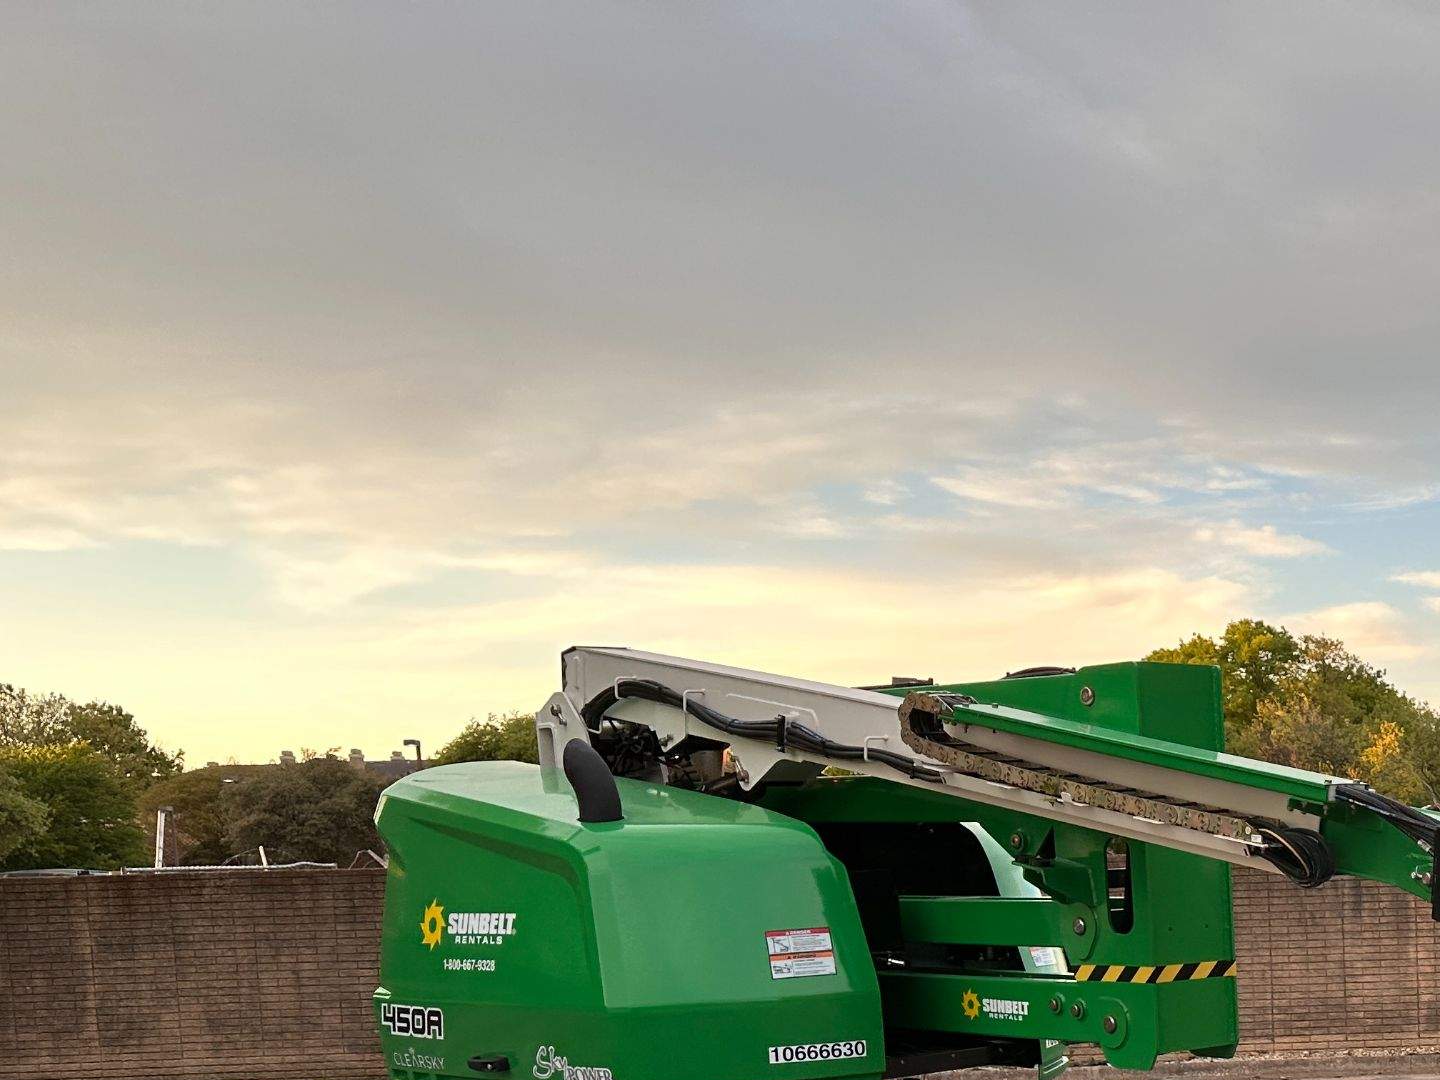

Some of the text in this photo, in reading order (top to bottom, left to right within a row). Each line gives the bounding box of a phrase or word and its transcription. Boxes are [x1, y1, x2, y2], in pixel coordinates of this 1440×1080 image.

[447, 912, 517, 935] SUNBELT
[454, 935, 503, 945] RENTALS
[443, 958, 496, 972] 1-800-667-9328
[982, 998, 1029, 1016] SUNBELT
[988, 1012, 1023, 1021] RENTALS
[381, 1003, 444, 1040] 450A
[393, 1049, 445, 1070] CLEARSKY
[771, 1041, 866, 1062] 10666630
